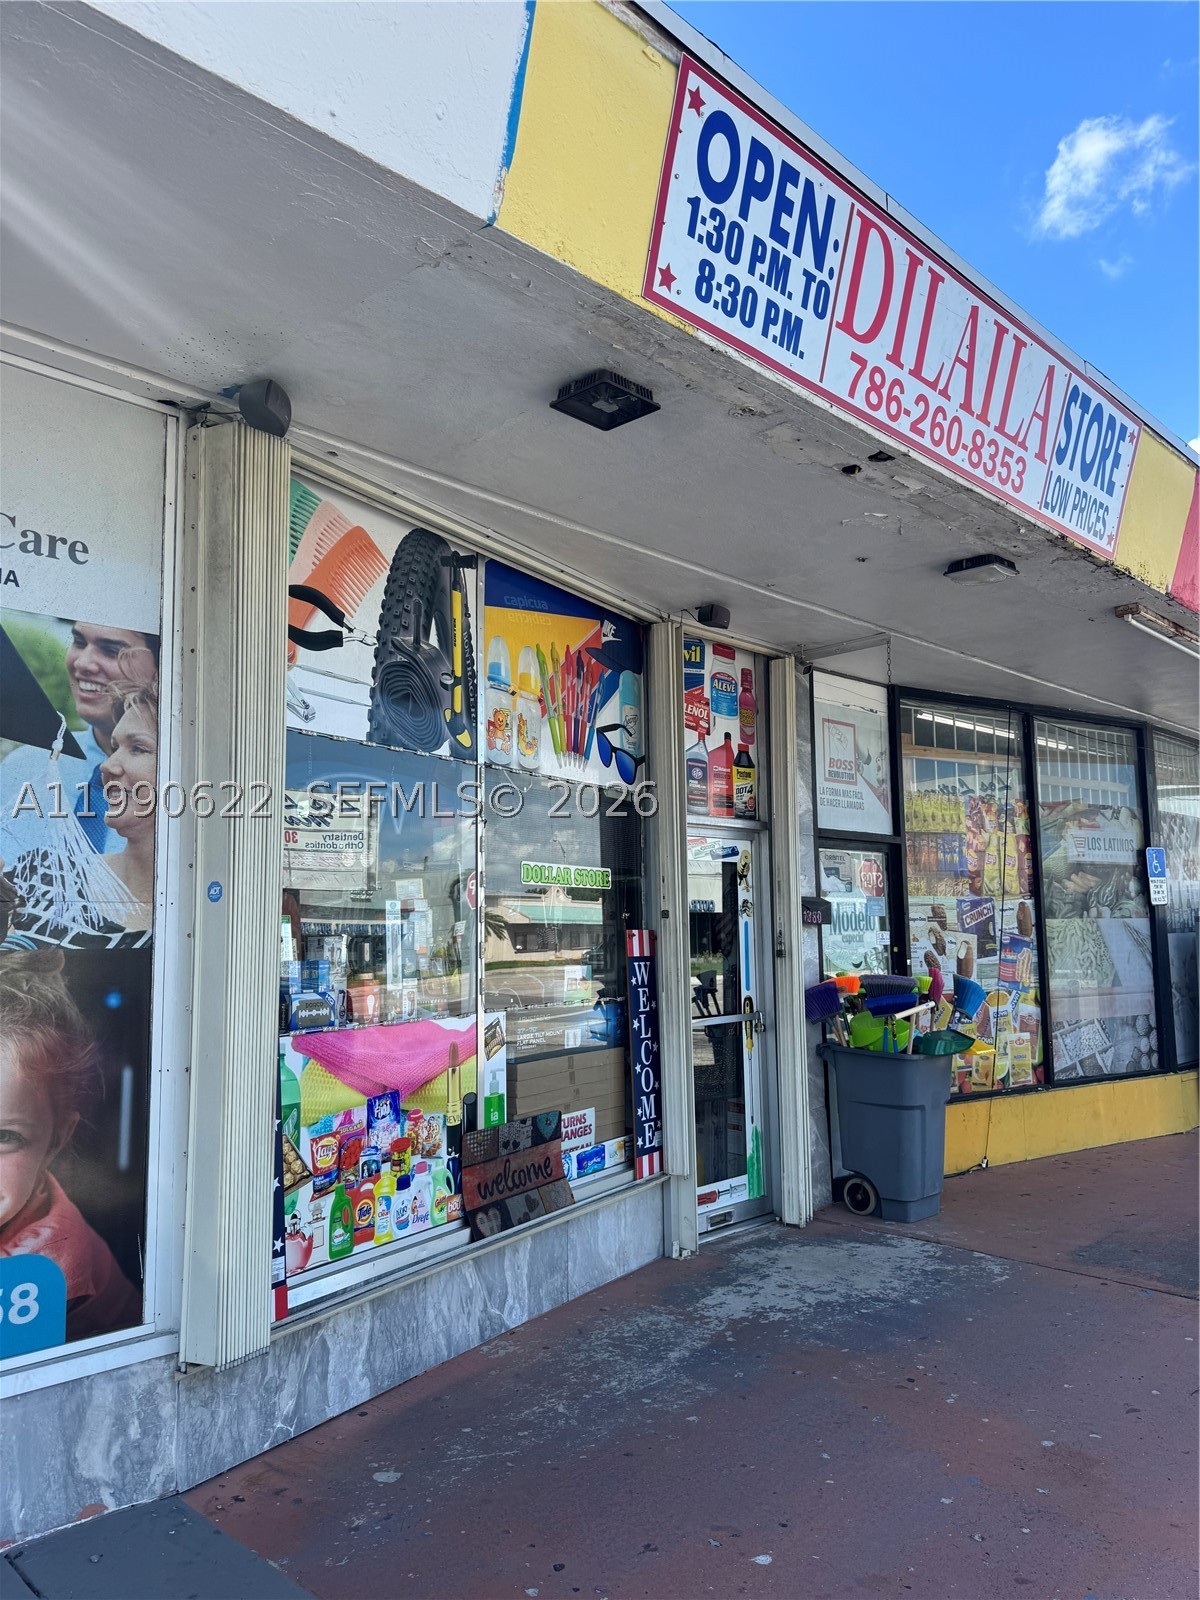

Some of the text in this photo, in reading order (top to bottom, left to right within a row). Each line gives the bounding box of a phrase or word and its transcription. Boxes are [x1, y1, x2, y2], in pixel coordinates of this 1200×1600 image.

[697, 110, 839, 281] OPEN:
[687, 196, 831, 320] 1:30 P.M. TO
[694, 258, 804, 360] 8:30 P.M.
[836, 208, 1056, 464] DILAILA
[848, 352, 1028, 494] 786-260-8353
[1055, 384, 1129, 498] STORE
[1043, 470, 1110, 542] LOW PRICES
[713, 679, 736, 692] ALEVE
[829, 757, 854, 771] BOSS
[1087, 837, 1135, 853] LOS LATINOS
[522, 864, 610, 888] DOLLAR STORE
[830, 903, 877, 935] Modelo
[964, 902, 992, 926] CRUNCH
[536, 1031, 546, 1039] TILT
[546, 1029, 563, 1037] MOUNT
[634, 961, 656, 1149] WELCOME
[477, 1156, 553, 1200] welcome
[357, 1207, 373, 1221] Tide
[411, 1212, 430, 1224] Dreft
